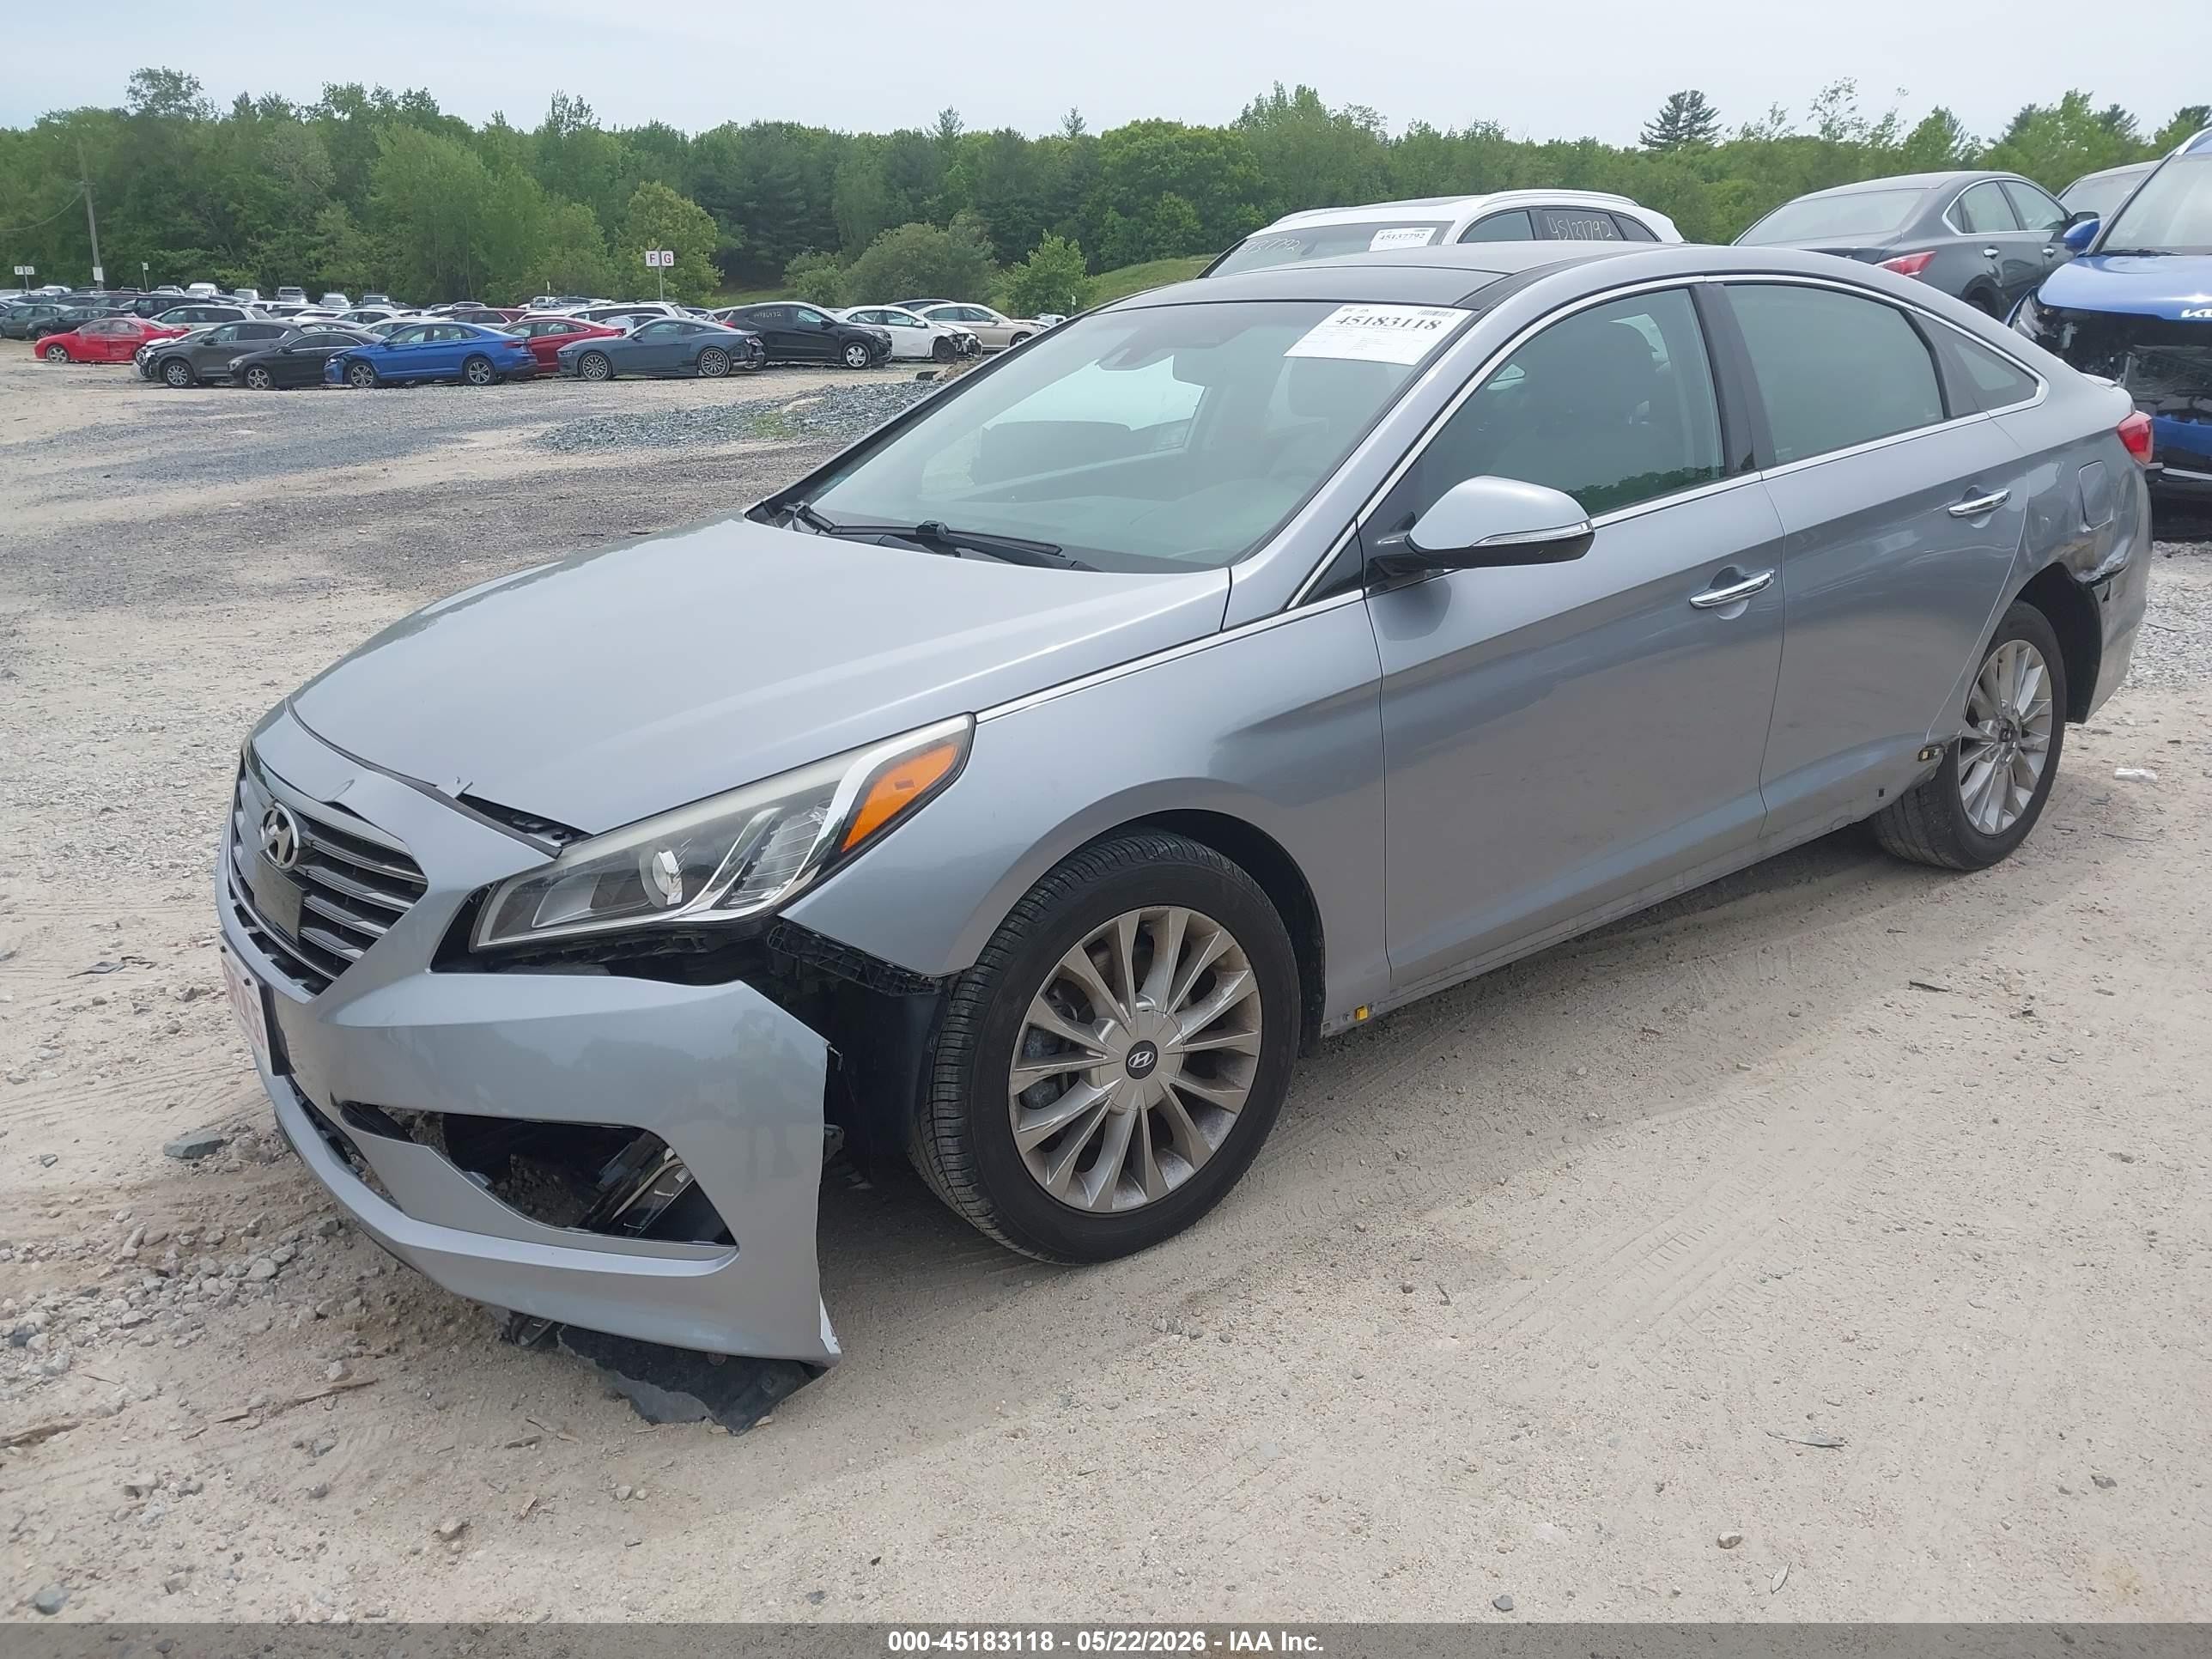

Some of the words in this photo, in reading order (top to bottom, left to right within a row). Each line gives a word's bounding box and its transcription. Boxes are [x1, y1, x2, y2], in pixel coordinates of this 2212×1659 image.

[649, 253, 656, 264] F
[664, 253, 672, 264] G
[1334, 315, 1443, 331] 45183118
